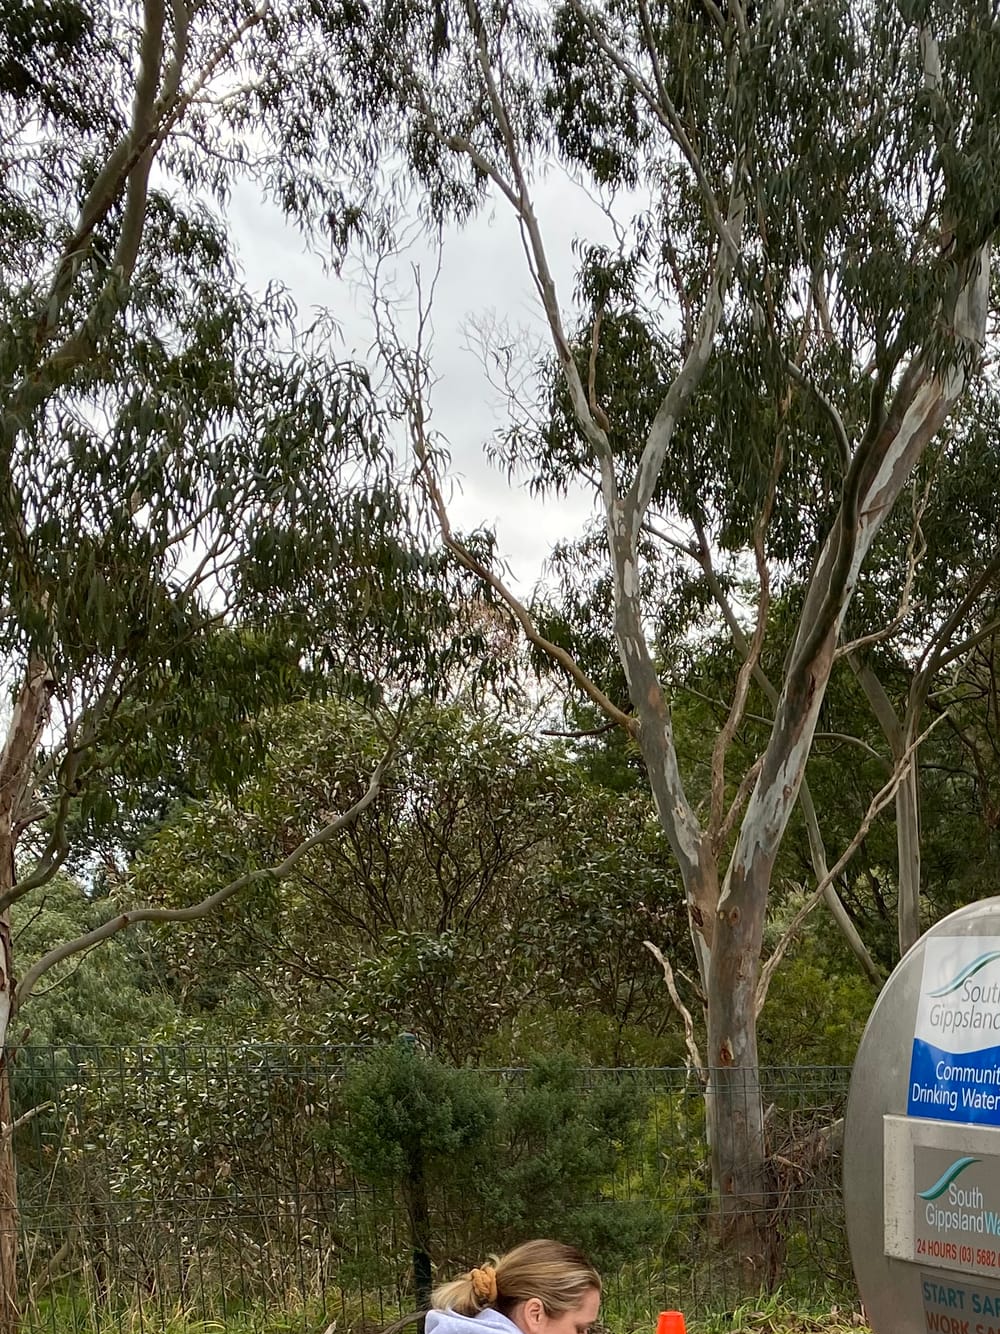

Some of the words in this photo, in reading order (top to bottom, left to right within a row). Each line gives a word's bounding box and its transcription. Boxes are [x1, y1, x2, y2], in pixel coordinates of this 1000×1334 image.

[912, 1083, 958, 1111] Drinking
[961, 1088, 1000, 1111] Water
[948, 1183, 984, 1209] South
[917, 1238, 927, 1255] 24
[928, 1240, 957, 1260] HOURS
[959, 1246, 975, 1267] (03)
[976, 1247, 996, 1267] 5682
[923, 1281, 966, 1310] START
